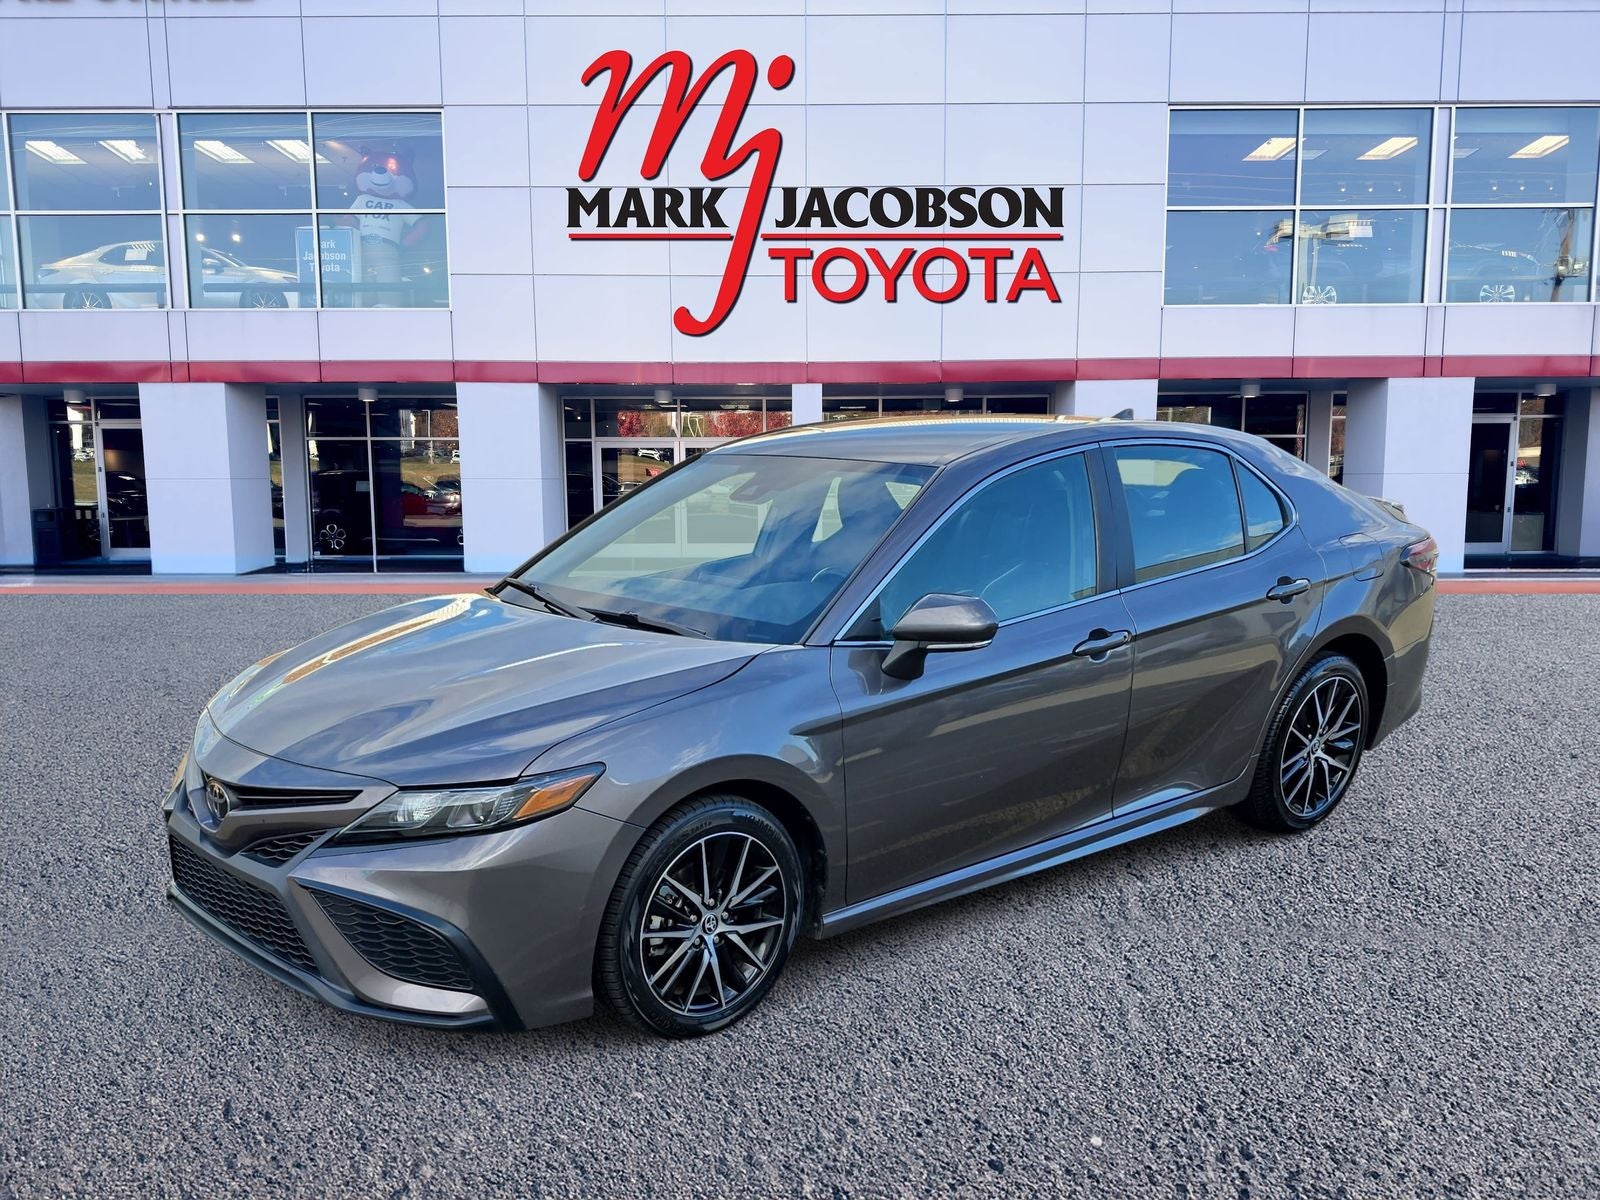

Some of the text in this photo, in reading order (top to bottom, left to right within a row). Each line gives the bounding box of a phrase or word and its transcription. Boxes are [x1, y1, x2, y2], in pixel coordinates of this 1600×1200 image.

[365, 199, 394, 210] CAR
[566, 187, 1064, 228] MARK JACOBSON
[309, 262, 340, 273] Tyota
[768, 247, 1062, 303] TOYOTA
